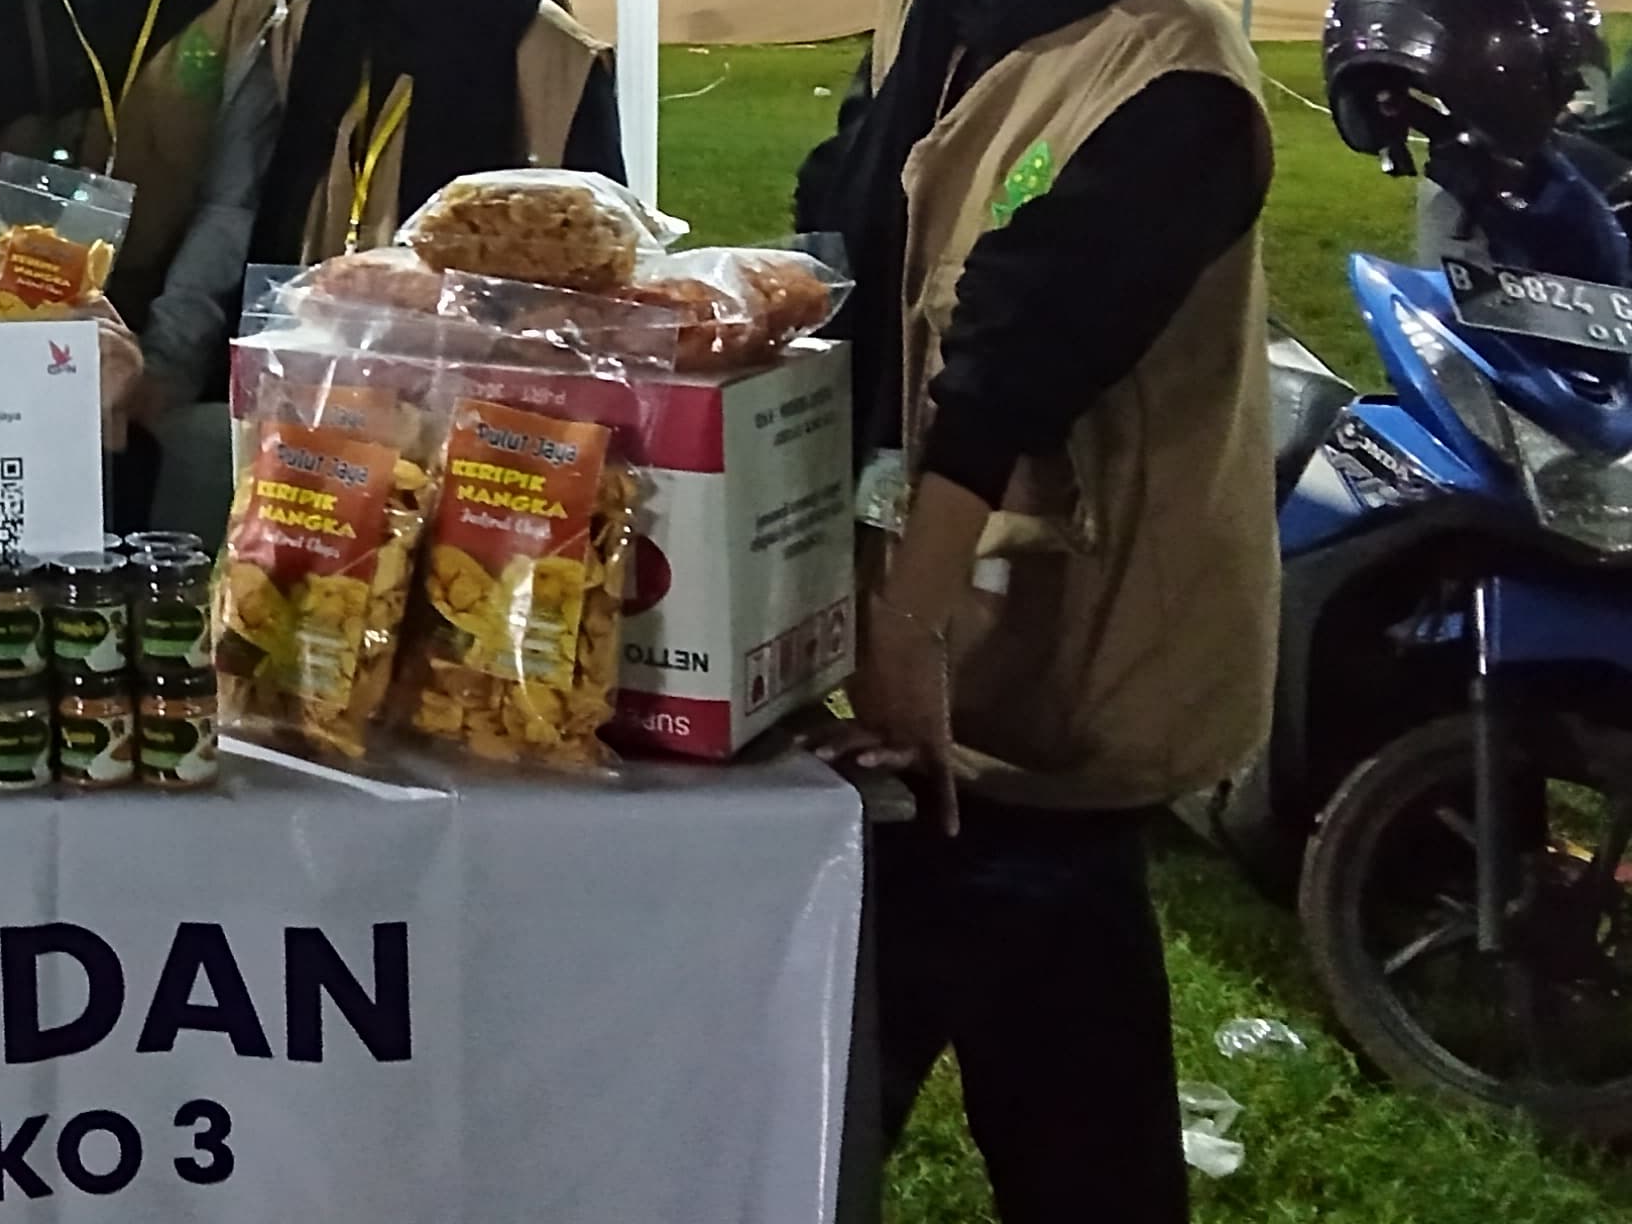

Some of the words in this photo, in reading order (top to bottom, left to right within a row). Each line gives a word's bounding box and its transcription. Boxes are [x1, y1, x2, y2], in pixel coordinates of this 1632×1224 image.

[1448, 262, 1473, 291] B
[452, 459, 546, 492] KERIPIK
[457, 485, 568, 519] NANGKA
[258, 505, 357, 539] NANGKA
[624, 643, 709, 672] NETTO
[173, 1099, 235, 1184] 3
